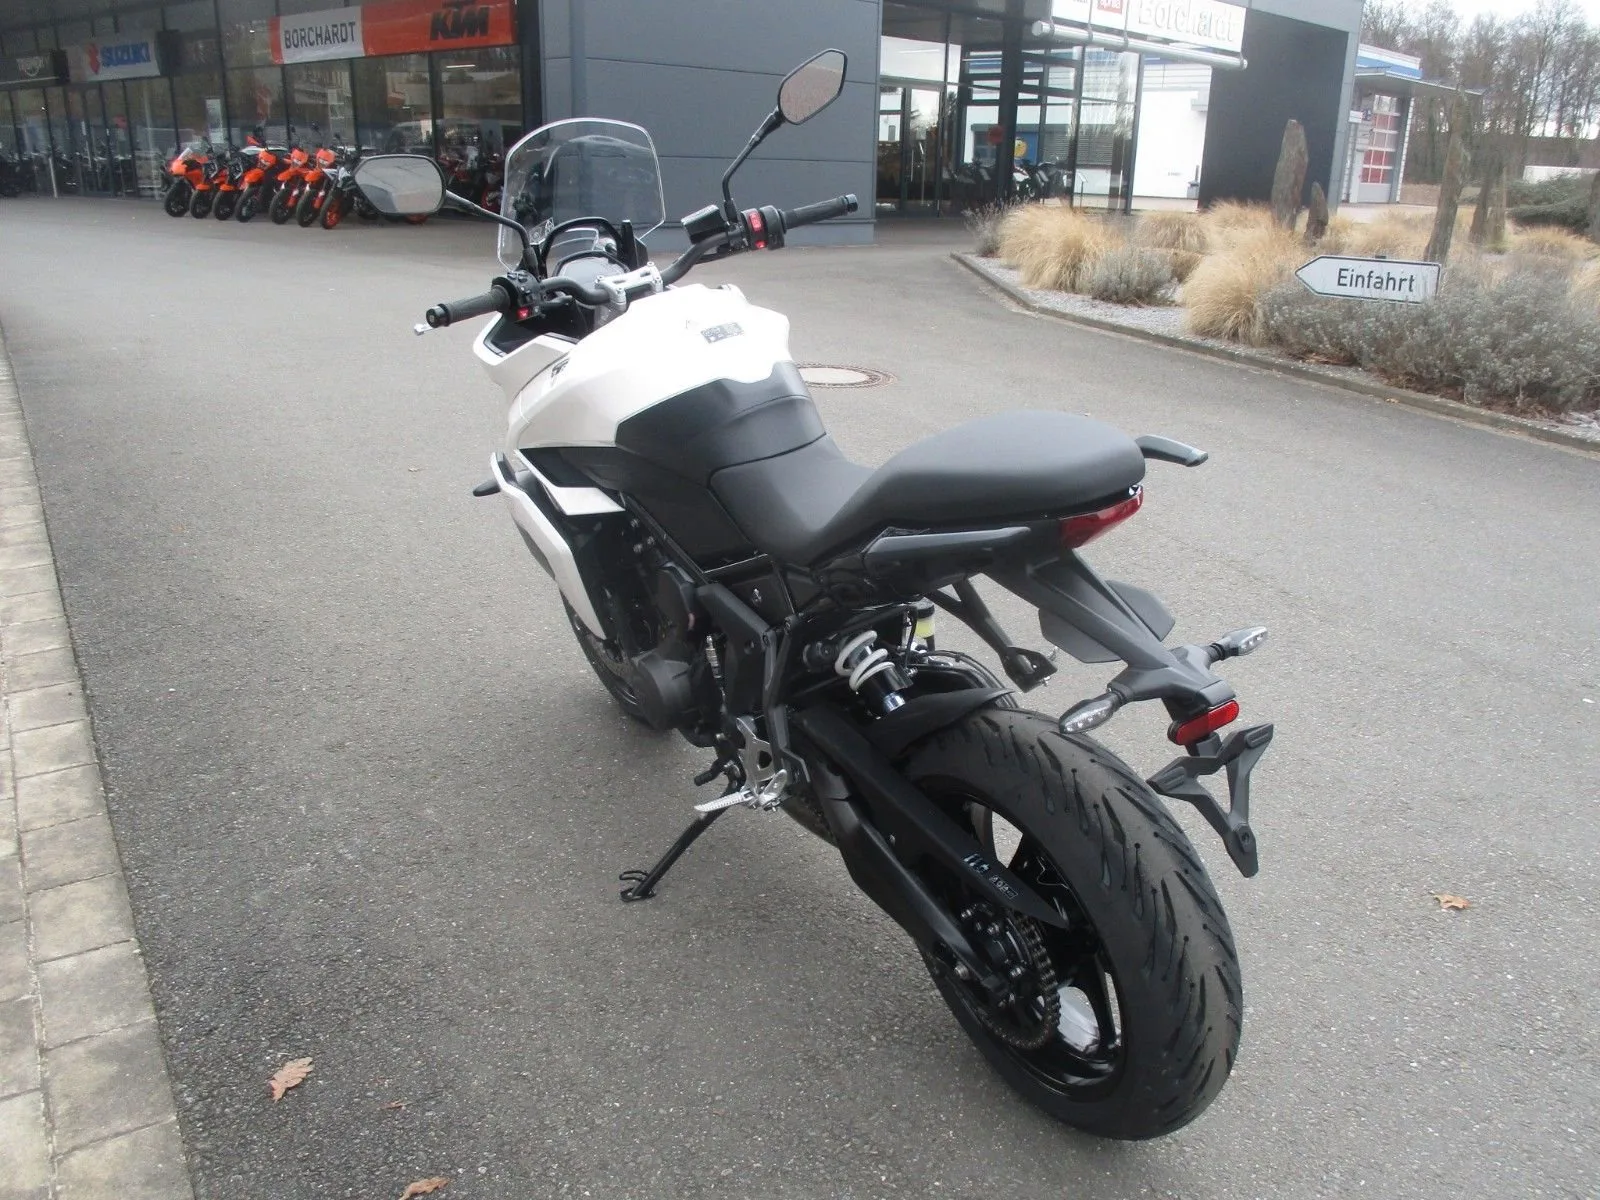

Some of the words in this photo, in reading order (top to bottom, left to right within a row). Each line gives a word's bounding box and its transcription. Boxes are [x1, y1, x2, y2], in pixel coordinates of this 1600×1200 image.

[284, 21, 356, 49] BORCHARDT
[430, 7, 491, 41] KTM
[1337, 268, 1415, 292] Einfahrt
